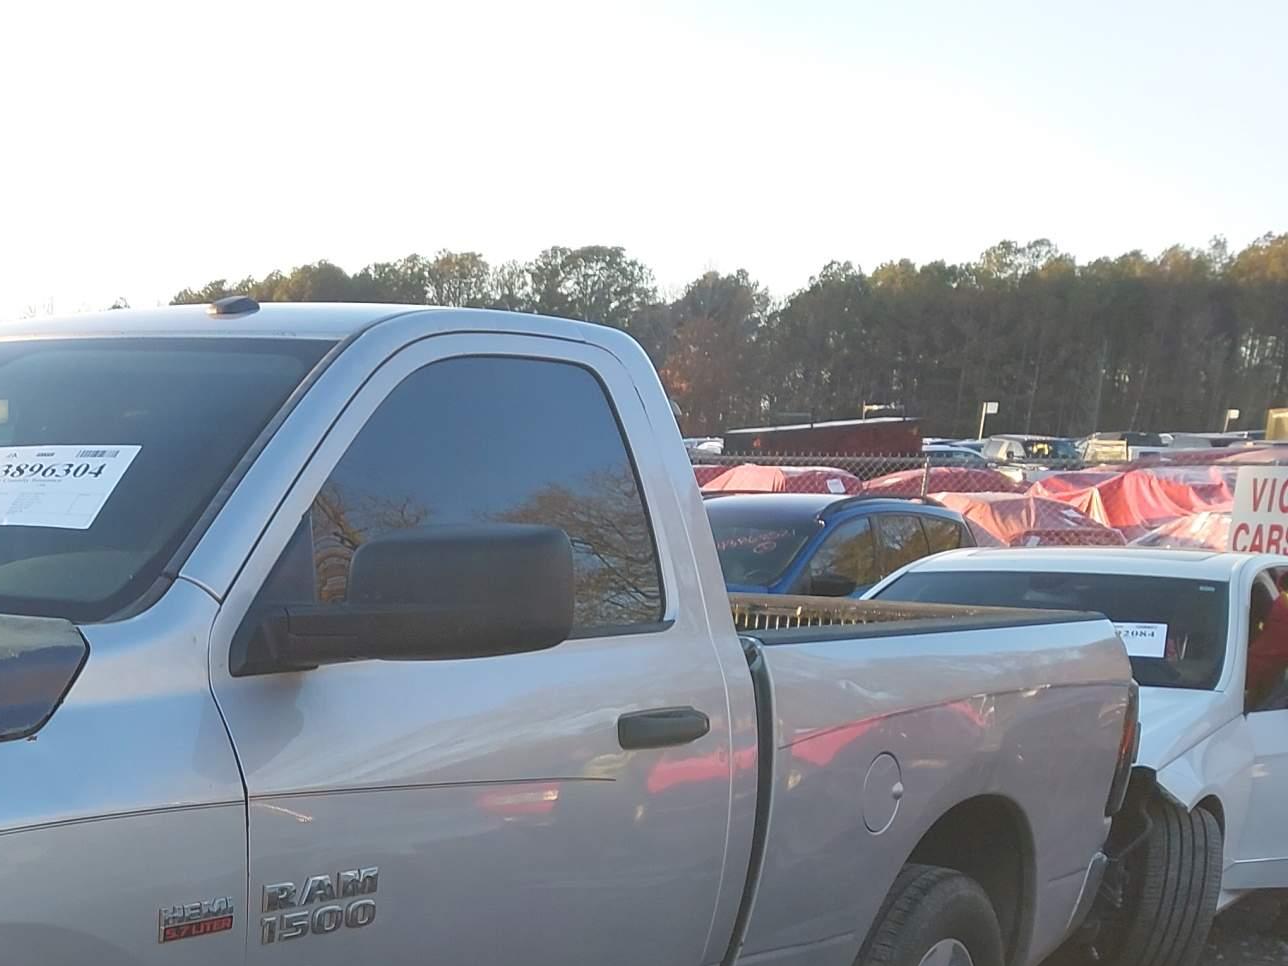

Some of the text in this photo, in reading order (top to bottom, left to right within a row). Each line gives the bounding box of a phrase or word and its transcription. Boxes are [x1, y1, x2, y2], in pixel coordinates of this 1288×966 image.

[159, 896, 233, 925] HEMI
[262, 866, 379, 913] RAM
[261, 899, 377, 945] 1500
